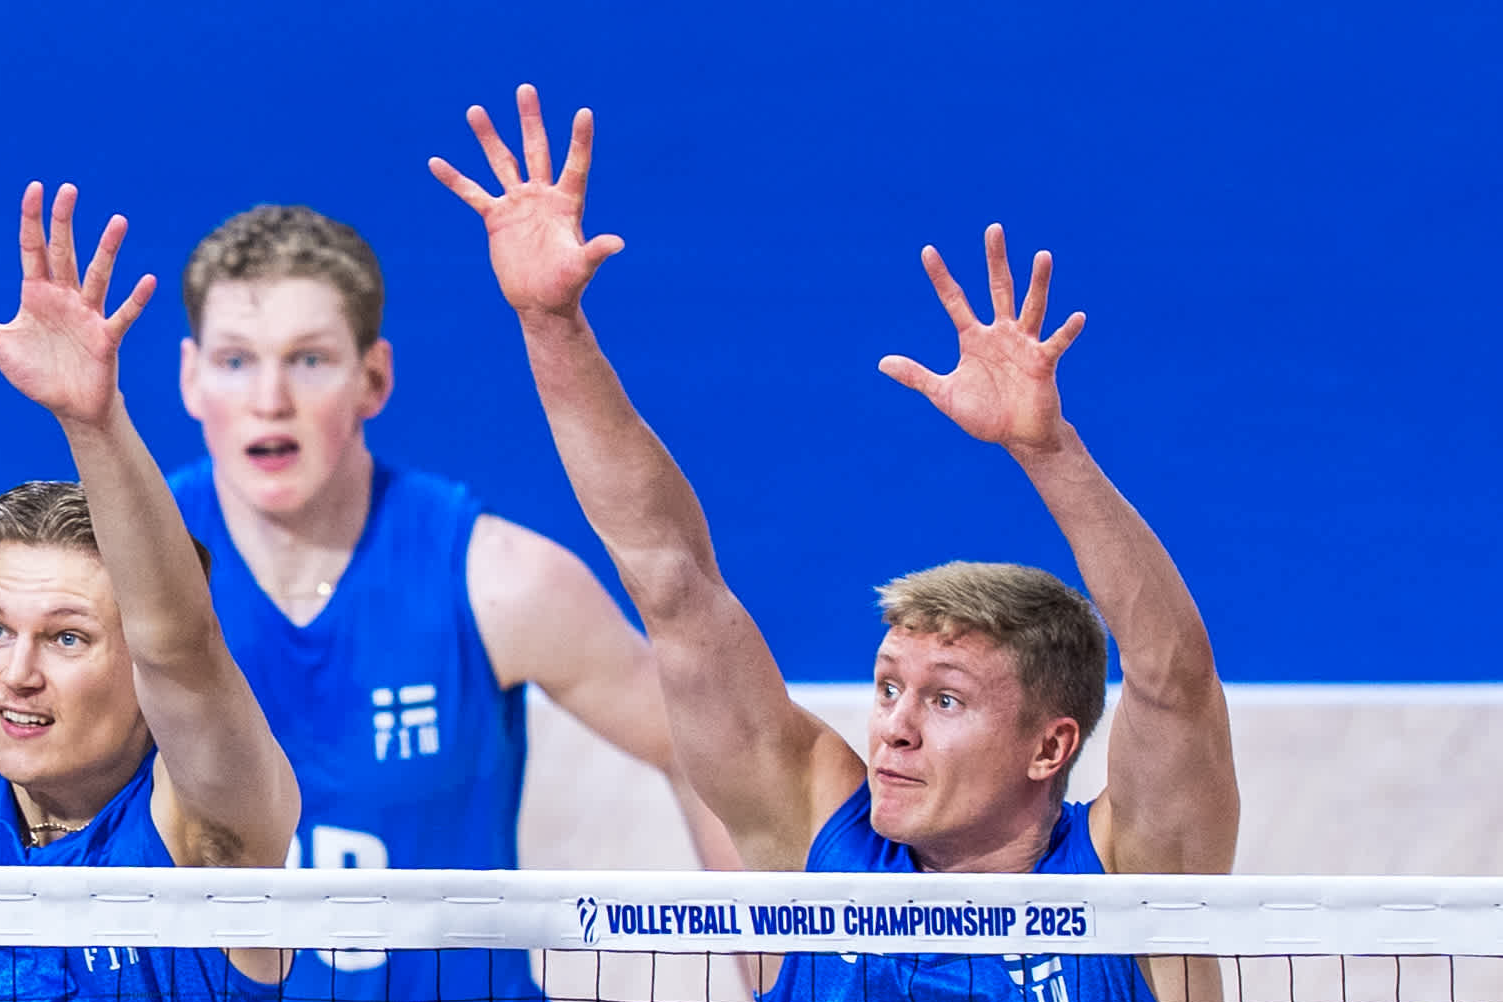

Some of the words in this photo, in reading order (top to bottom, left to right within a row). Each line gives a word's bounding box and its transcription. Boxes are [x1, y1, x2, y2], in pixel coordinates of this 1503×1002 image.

[606, 904, 742, 936] VOLLEYBALL
[751, 905, 836, 937] WORLD
[843, 905, 1017, 938] CHAMPIONSHIP
[1025, 906, 1087, 937] 2025
